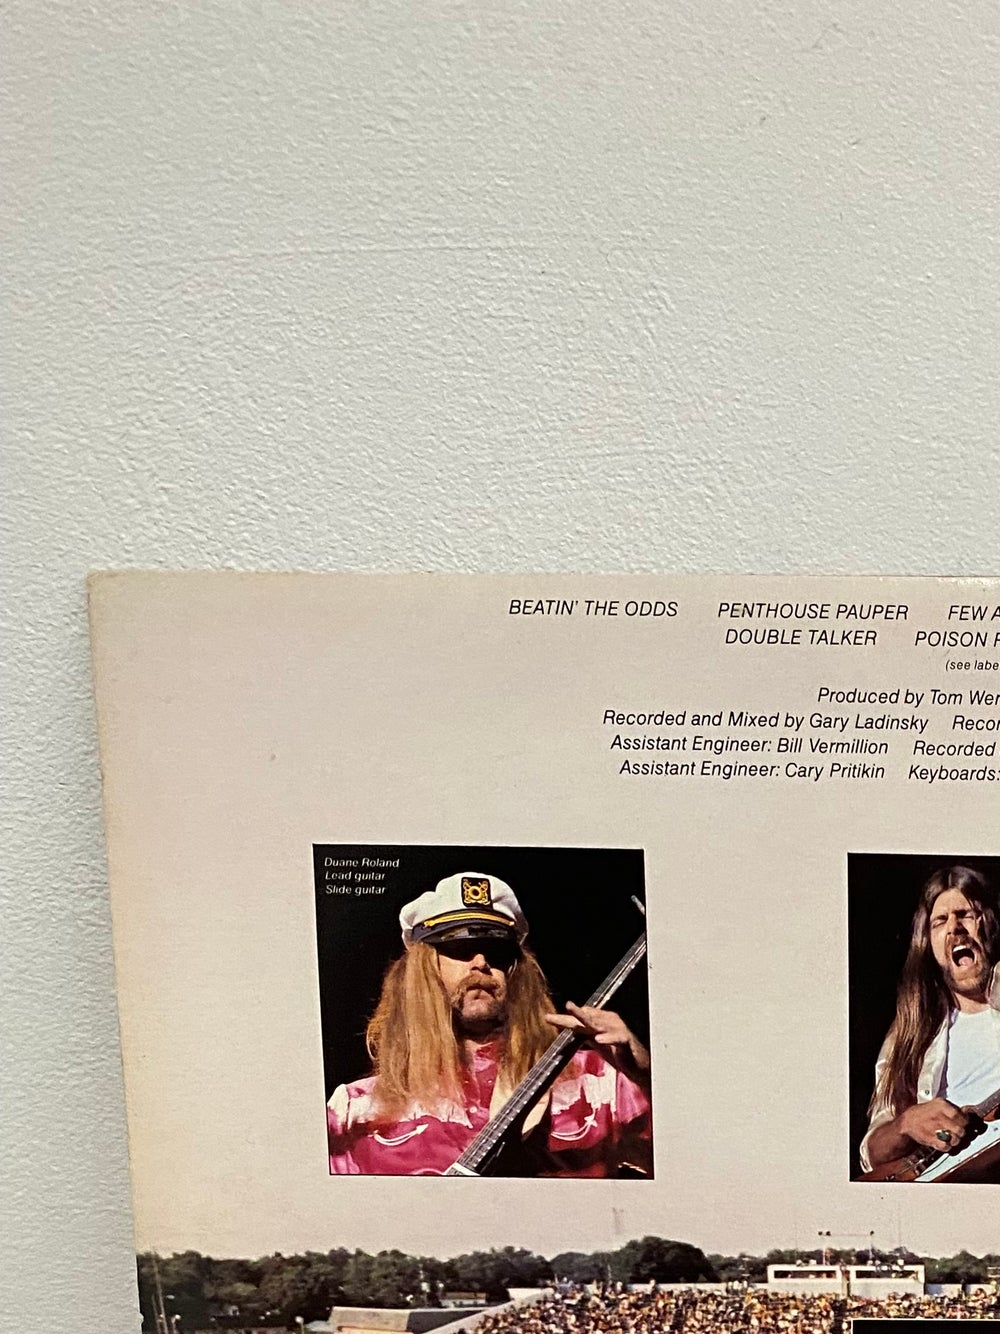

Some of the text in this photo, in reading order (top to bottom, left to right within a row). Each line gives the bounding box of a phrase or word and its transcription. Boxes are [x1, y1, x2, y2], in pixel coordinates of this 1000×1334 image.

[508, 599, 579, 616] BEATIN'
[584, 600, 620, 616] THE
[624, 600, 679, 617] ODDS
[717, 602, 831, 620] PENTHOUSE
[835, 603, 909, 621] PAUPER
[947, 604, 989, 622] FEW
[725, 628, 803, 645] DOUBLE
[808, 629, 878, 646] TALKER
[914, 630, 988, 648] POISON
[945, 659, 971, 672] (see
[817, 687, 901, 705] Produced
[903, 688, 925, 709] by
[930, 688, 963, 705] Tom
[602, 709, 687, 726] Recorded
[690, 711, 723, 727] and
[727, 710, 780, 728] Mixed
[783, 712, 805, 732] by
[809, 712, 850, 733] Gary
[854, 713, 929, 735] Ladinsky
[610, 734, 688, 751] Assistant
[692, 735, 772, 756] Engineer:
[776, 737, 803, 753] Bill
[809, 737, 889, 755] Vermillion
[912, 740, 997, 757] Recorded
[619, 759, 697, 776] Assistant
[700, 760, 781, 780] Engineer:
[785, 762, 825, 782] Cary
[829, 762, 885, 779] Pritikin
[324, 857, 400, 868] Duane Roland
[325, 871, 386, 883] Lead guitar
[325, 884, 386, 897] Slide guitar
